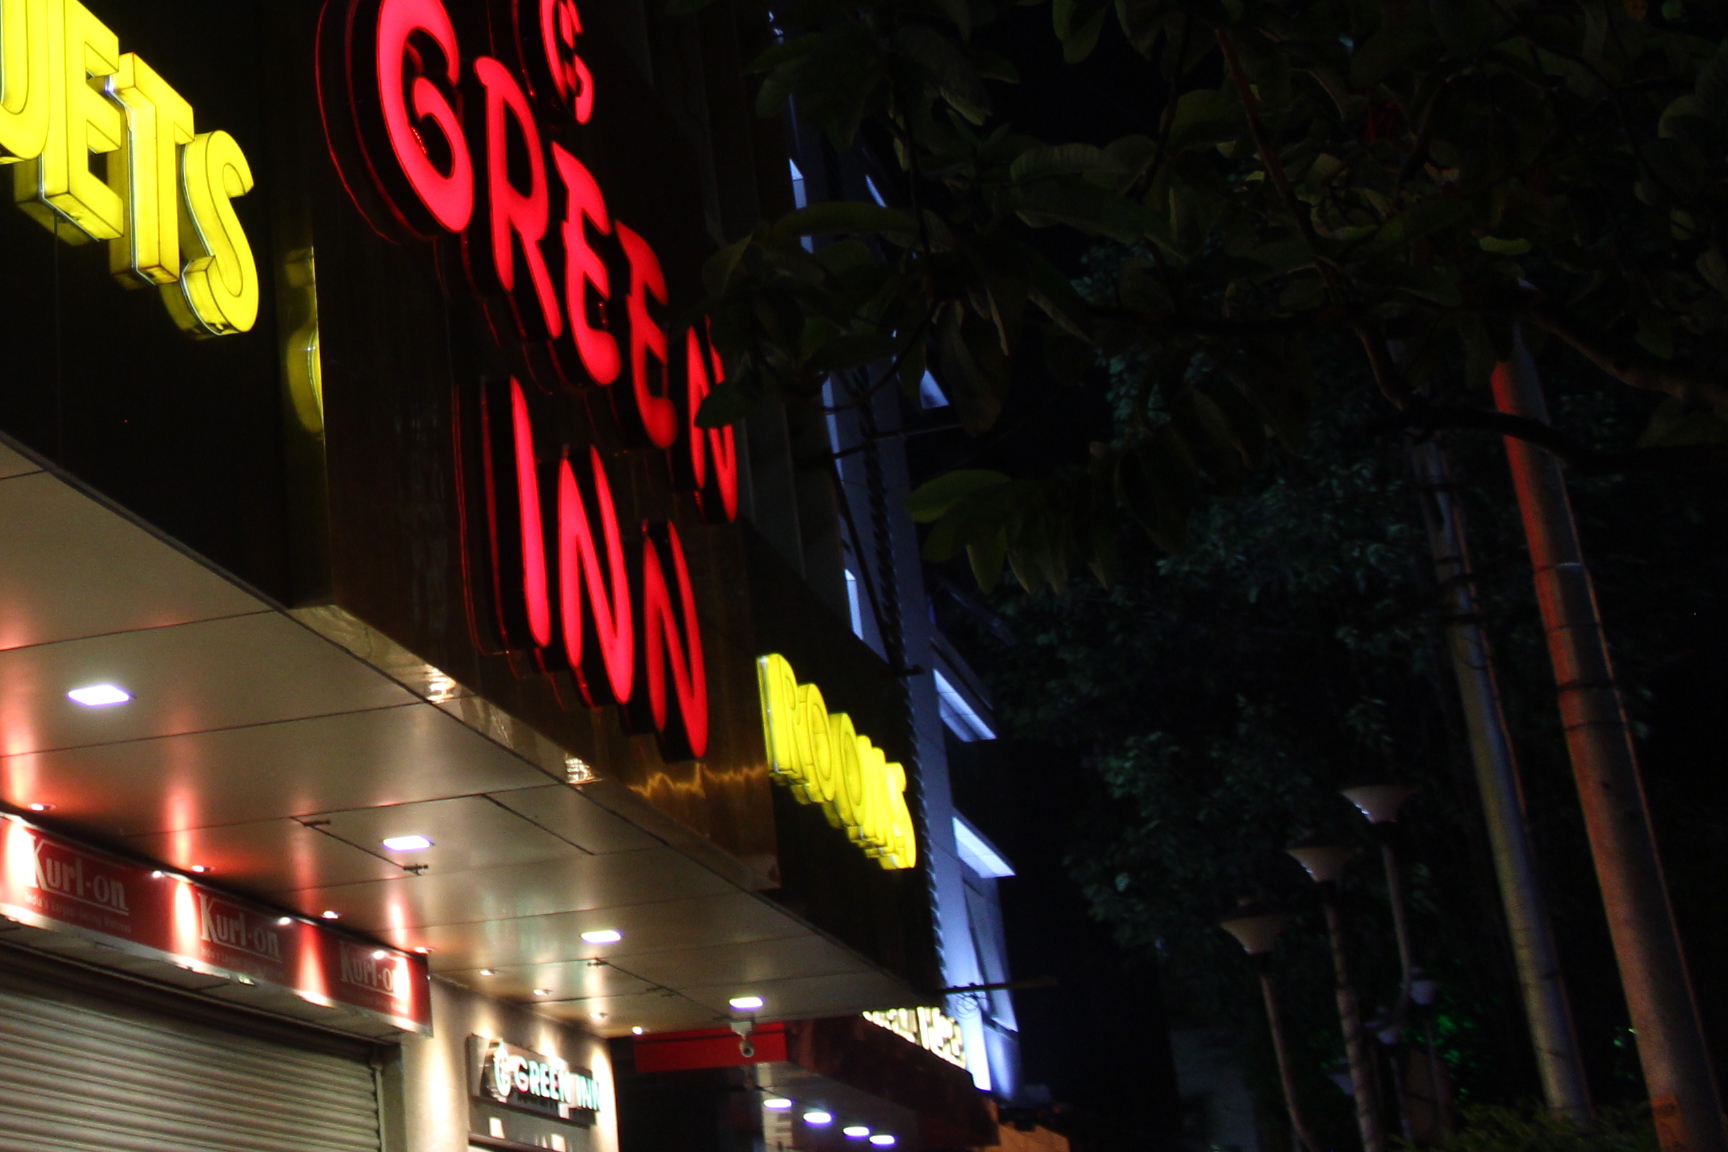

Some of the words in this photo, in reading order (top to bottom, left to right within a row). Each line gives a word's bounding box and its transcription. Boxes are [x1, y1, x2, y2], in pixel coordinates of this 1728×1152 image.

[511, 376, 709, 758] INN
[513, 1055, 571, 1103] GREEN
[576, 1074, 601, 1111] INN
